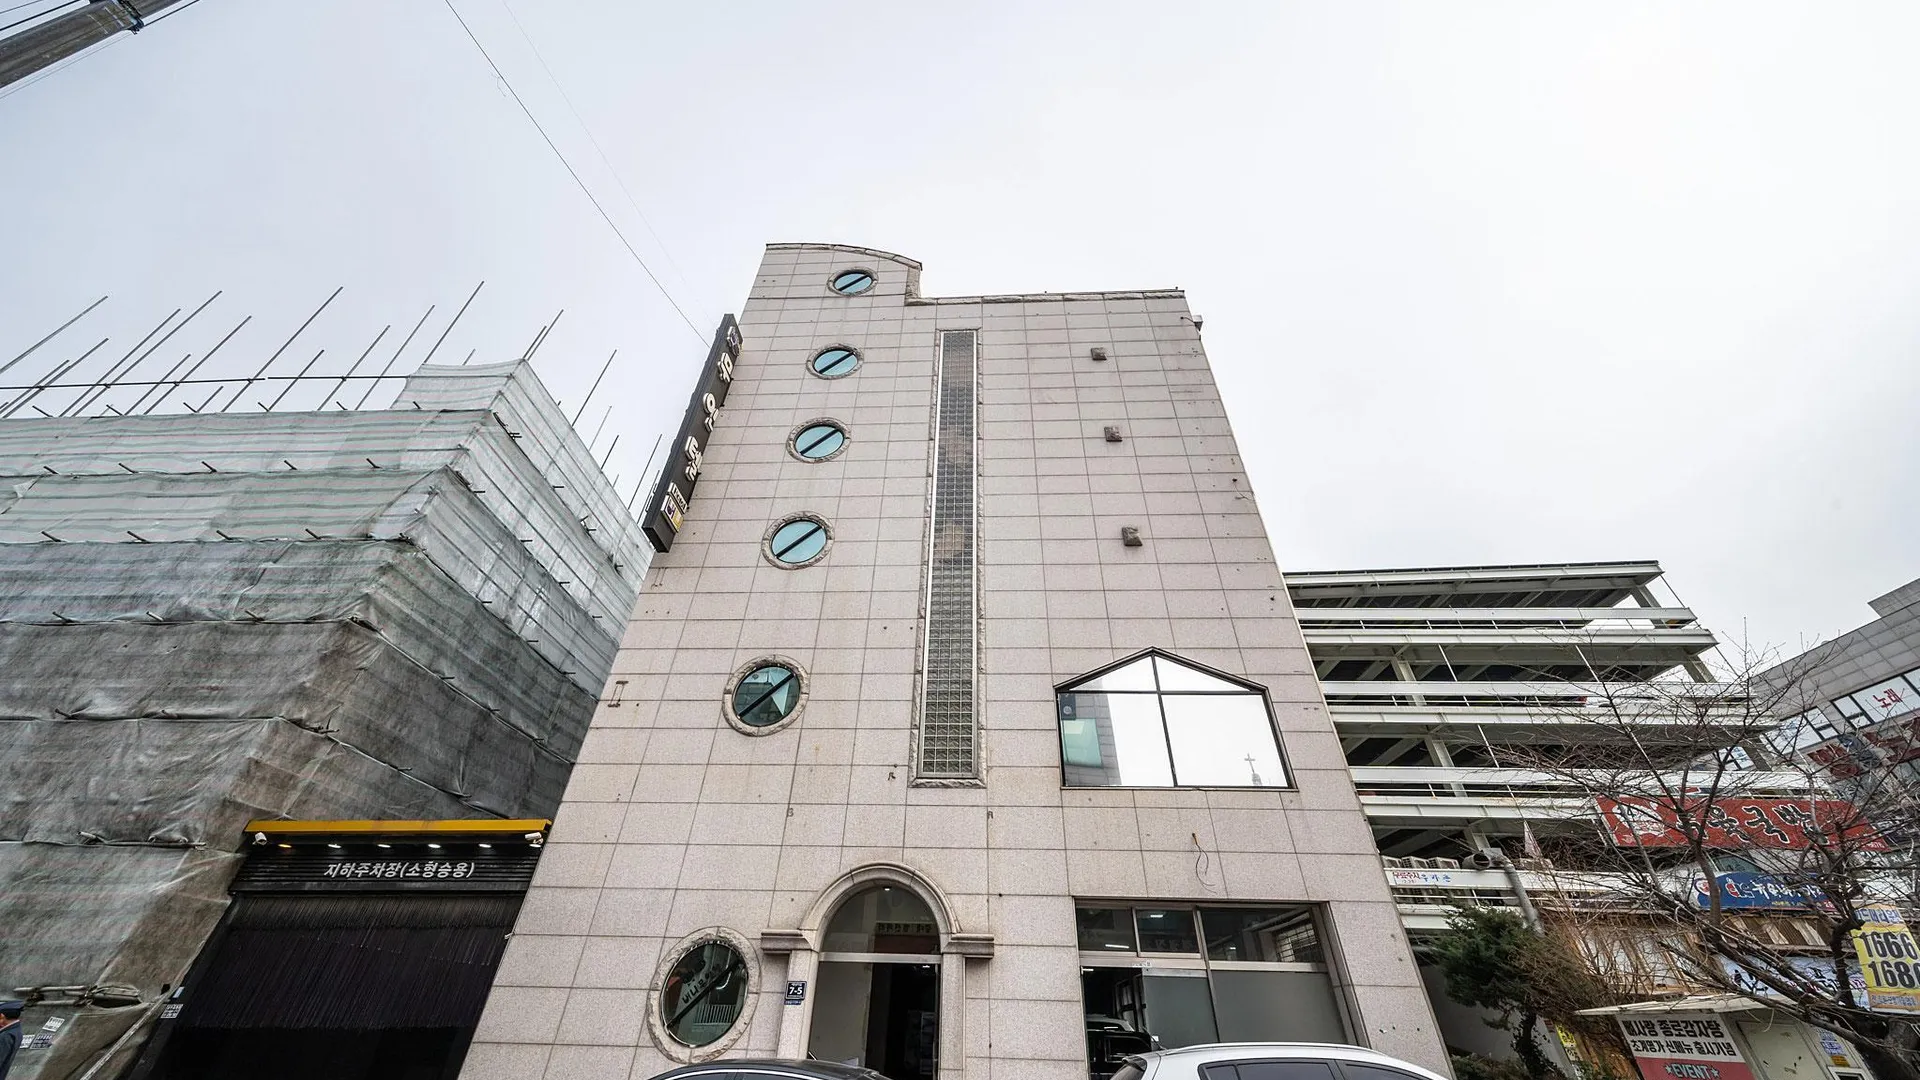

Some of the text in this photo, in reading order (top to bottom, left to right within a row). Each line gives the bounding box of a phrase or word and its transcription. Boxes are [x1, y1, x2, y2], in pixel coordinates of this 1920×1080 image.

[324, 861, 475, 878] 지하주차장(소형승용)
[1859, 930, 1919, 960] 1666
[789, 986, 803, 995] 7-5
[1657, 1020, 1725, 1038] 종로감자탕
[1693, 1041, 1737, 1056] 출시기념
[1671, 1063, 1711, 1079] EVENT
